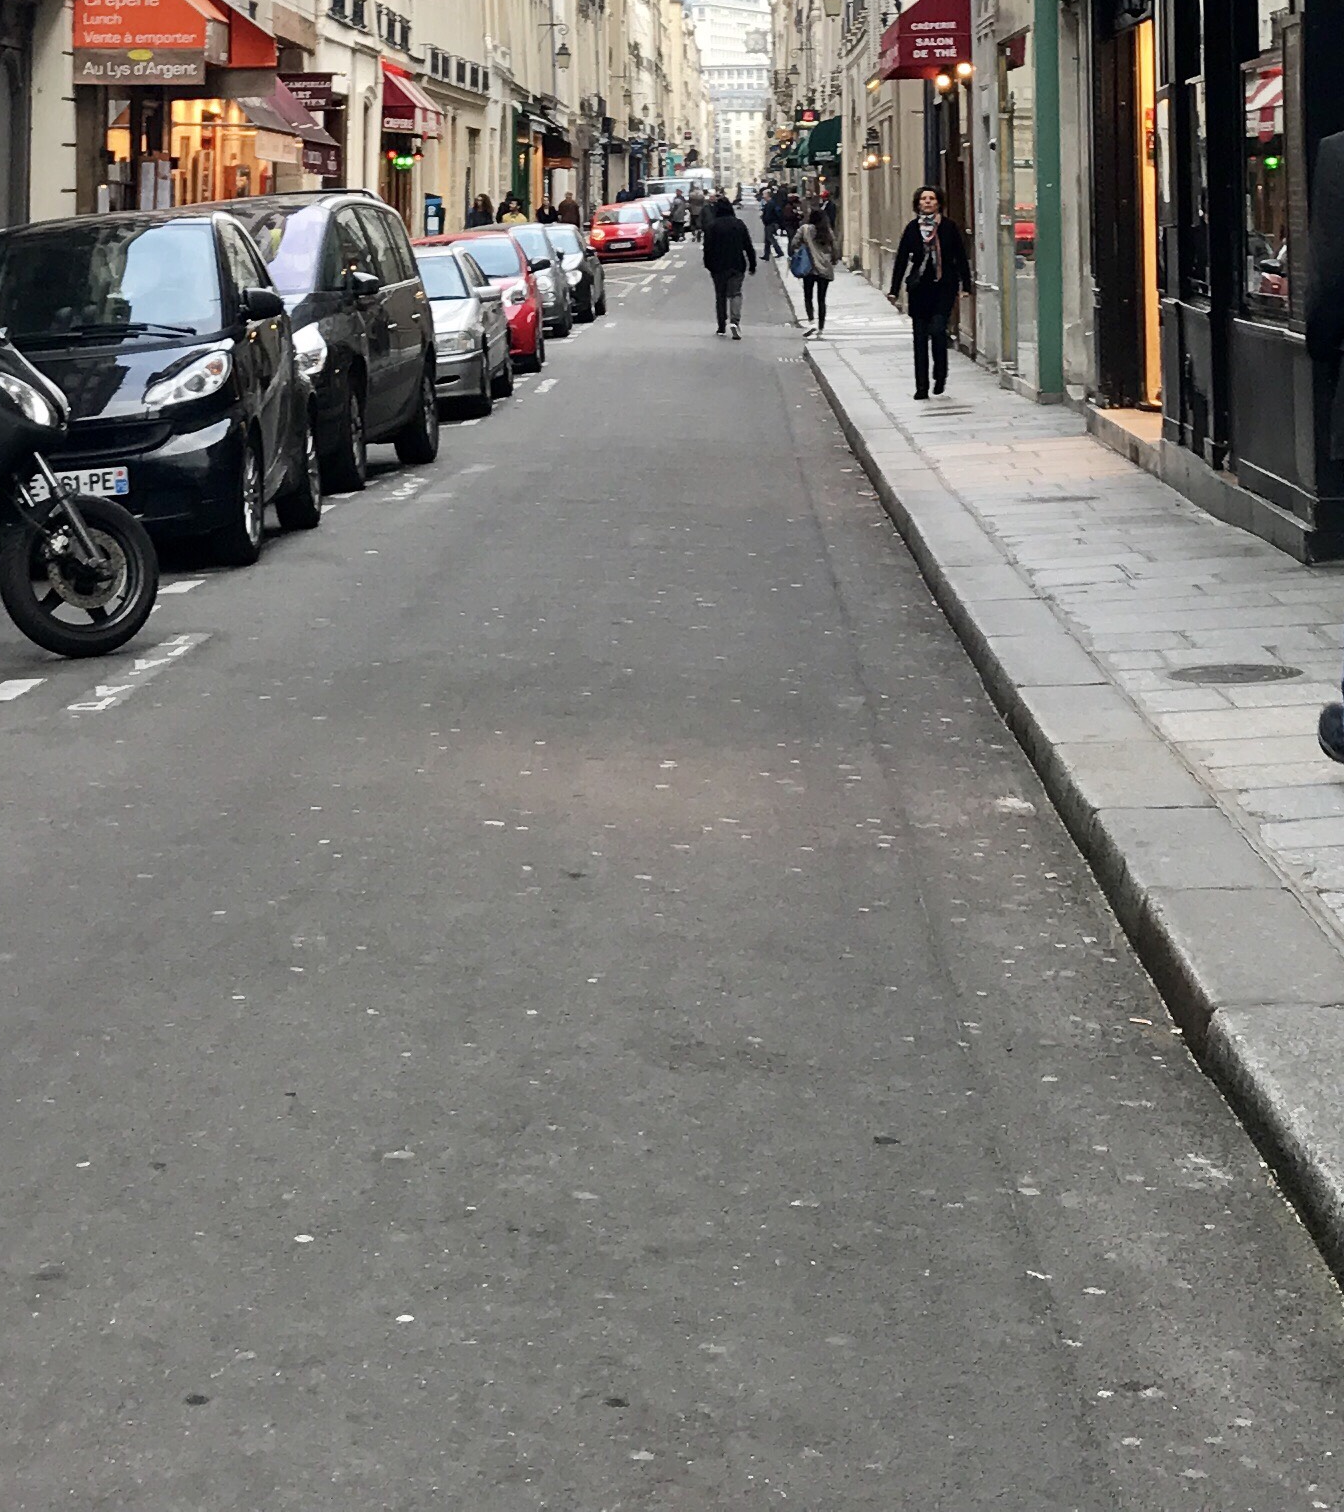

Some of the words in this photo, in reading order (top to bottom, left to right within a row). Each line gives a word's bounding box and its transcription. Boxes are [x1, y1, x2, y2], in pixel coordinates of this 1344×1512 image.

[83, 13, 123, 25] Lunch
[83, 31, 122, 44] Vente
[123, 32, 131, 44] à
[135, 33, 197, 46] emporter
[916, 37, 954, 47] SALON
[913, 50, 929, 58] DE
[934, 45, 958, 58] THÉ
[83, 61, 104, 76] Au
[106, 61, 131, 79] Lys
[133, 61, 198, 79] d'Argent
